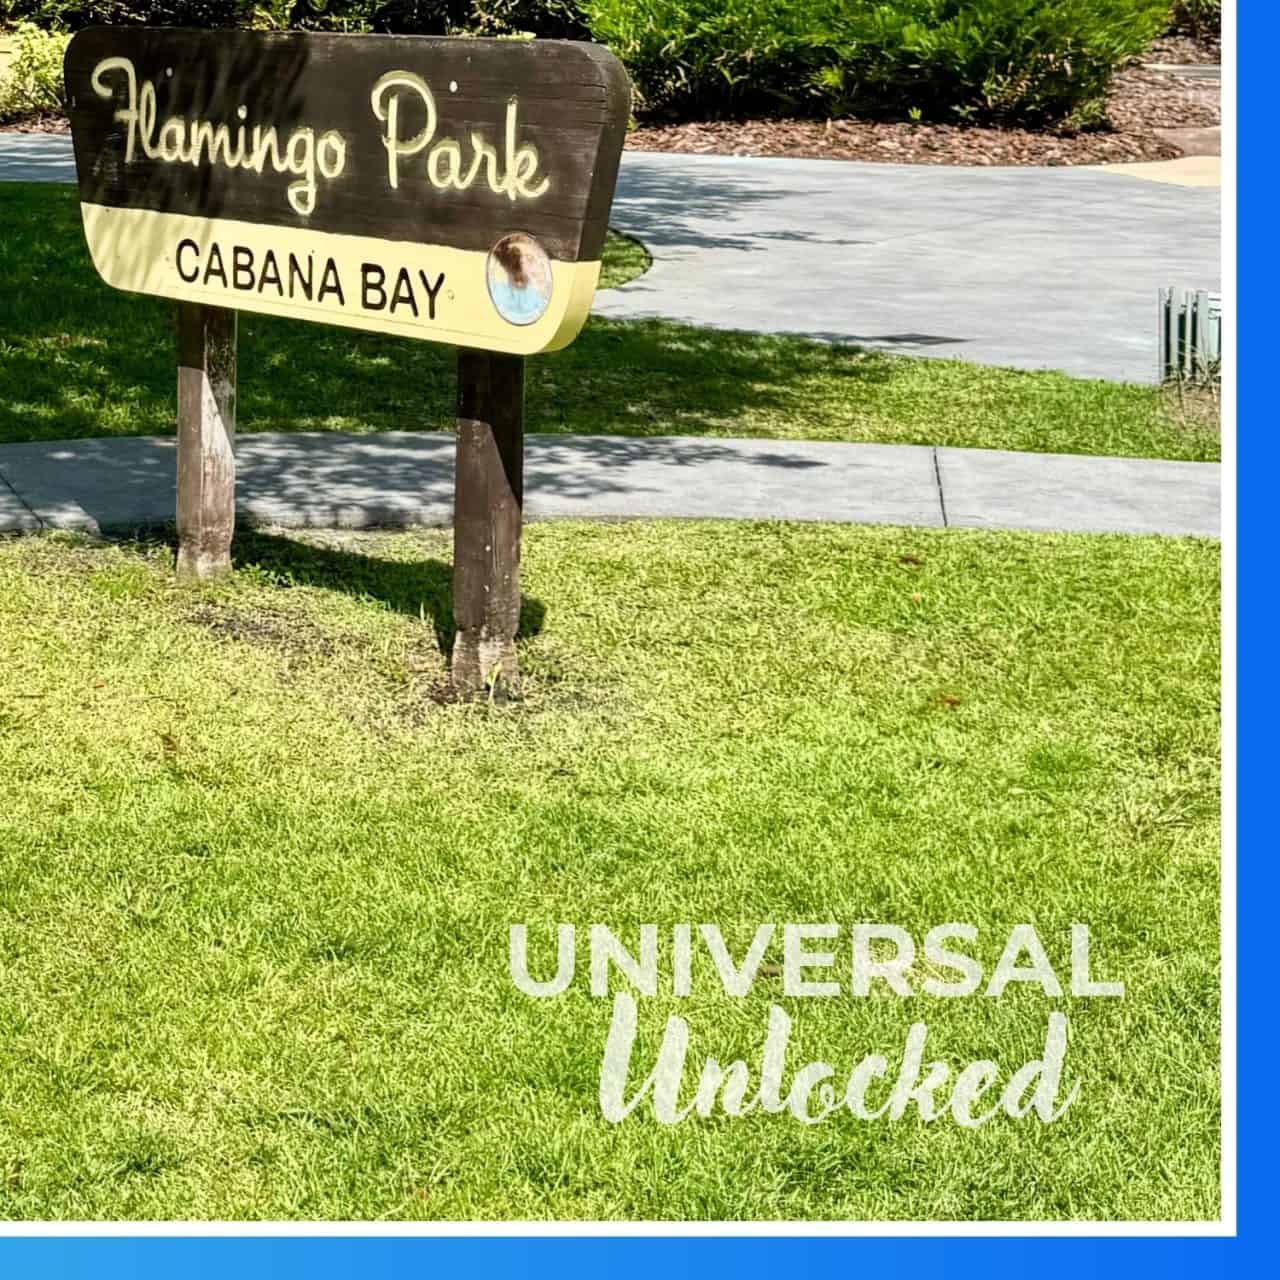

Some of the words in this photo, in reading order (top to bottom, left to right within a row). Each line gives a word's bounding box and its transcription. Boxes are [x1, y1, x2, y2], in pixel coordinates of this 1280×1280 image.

[91, 56, 347, 215] Flamingo
[371, 69, 551, 200] Park
[175, 238, 345, 306] CABANA
[361, 262, 446, 320] BAY
